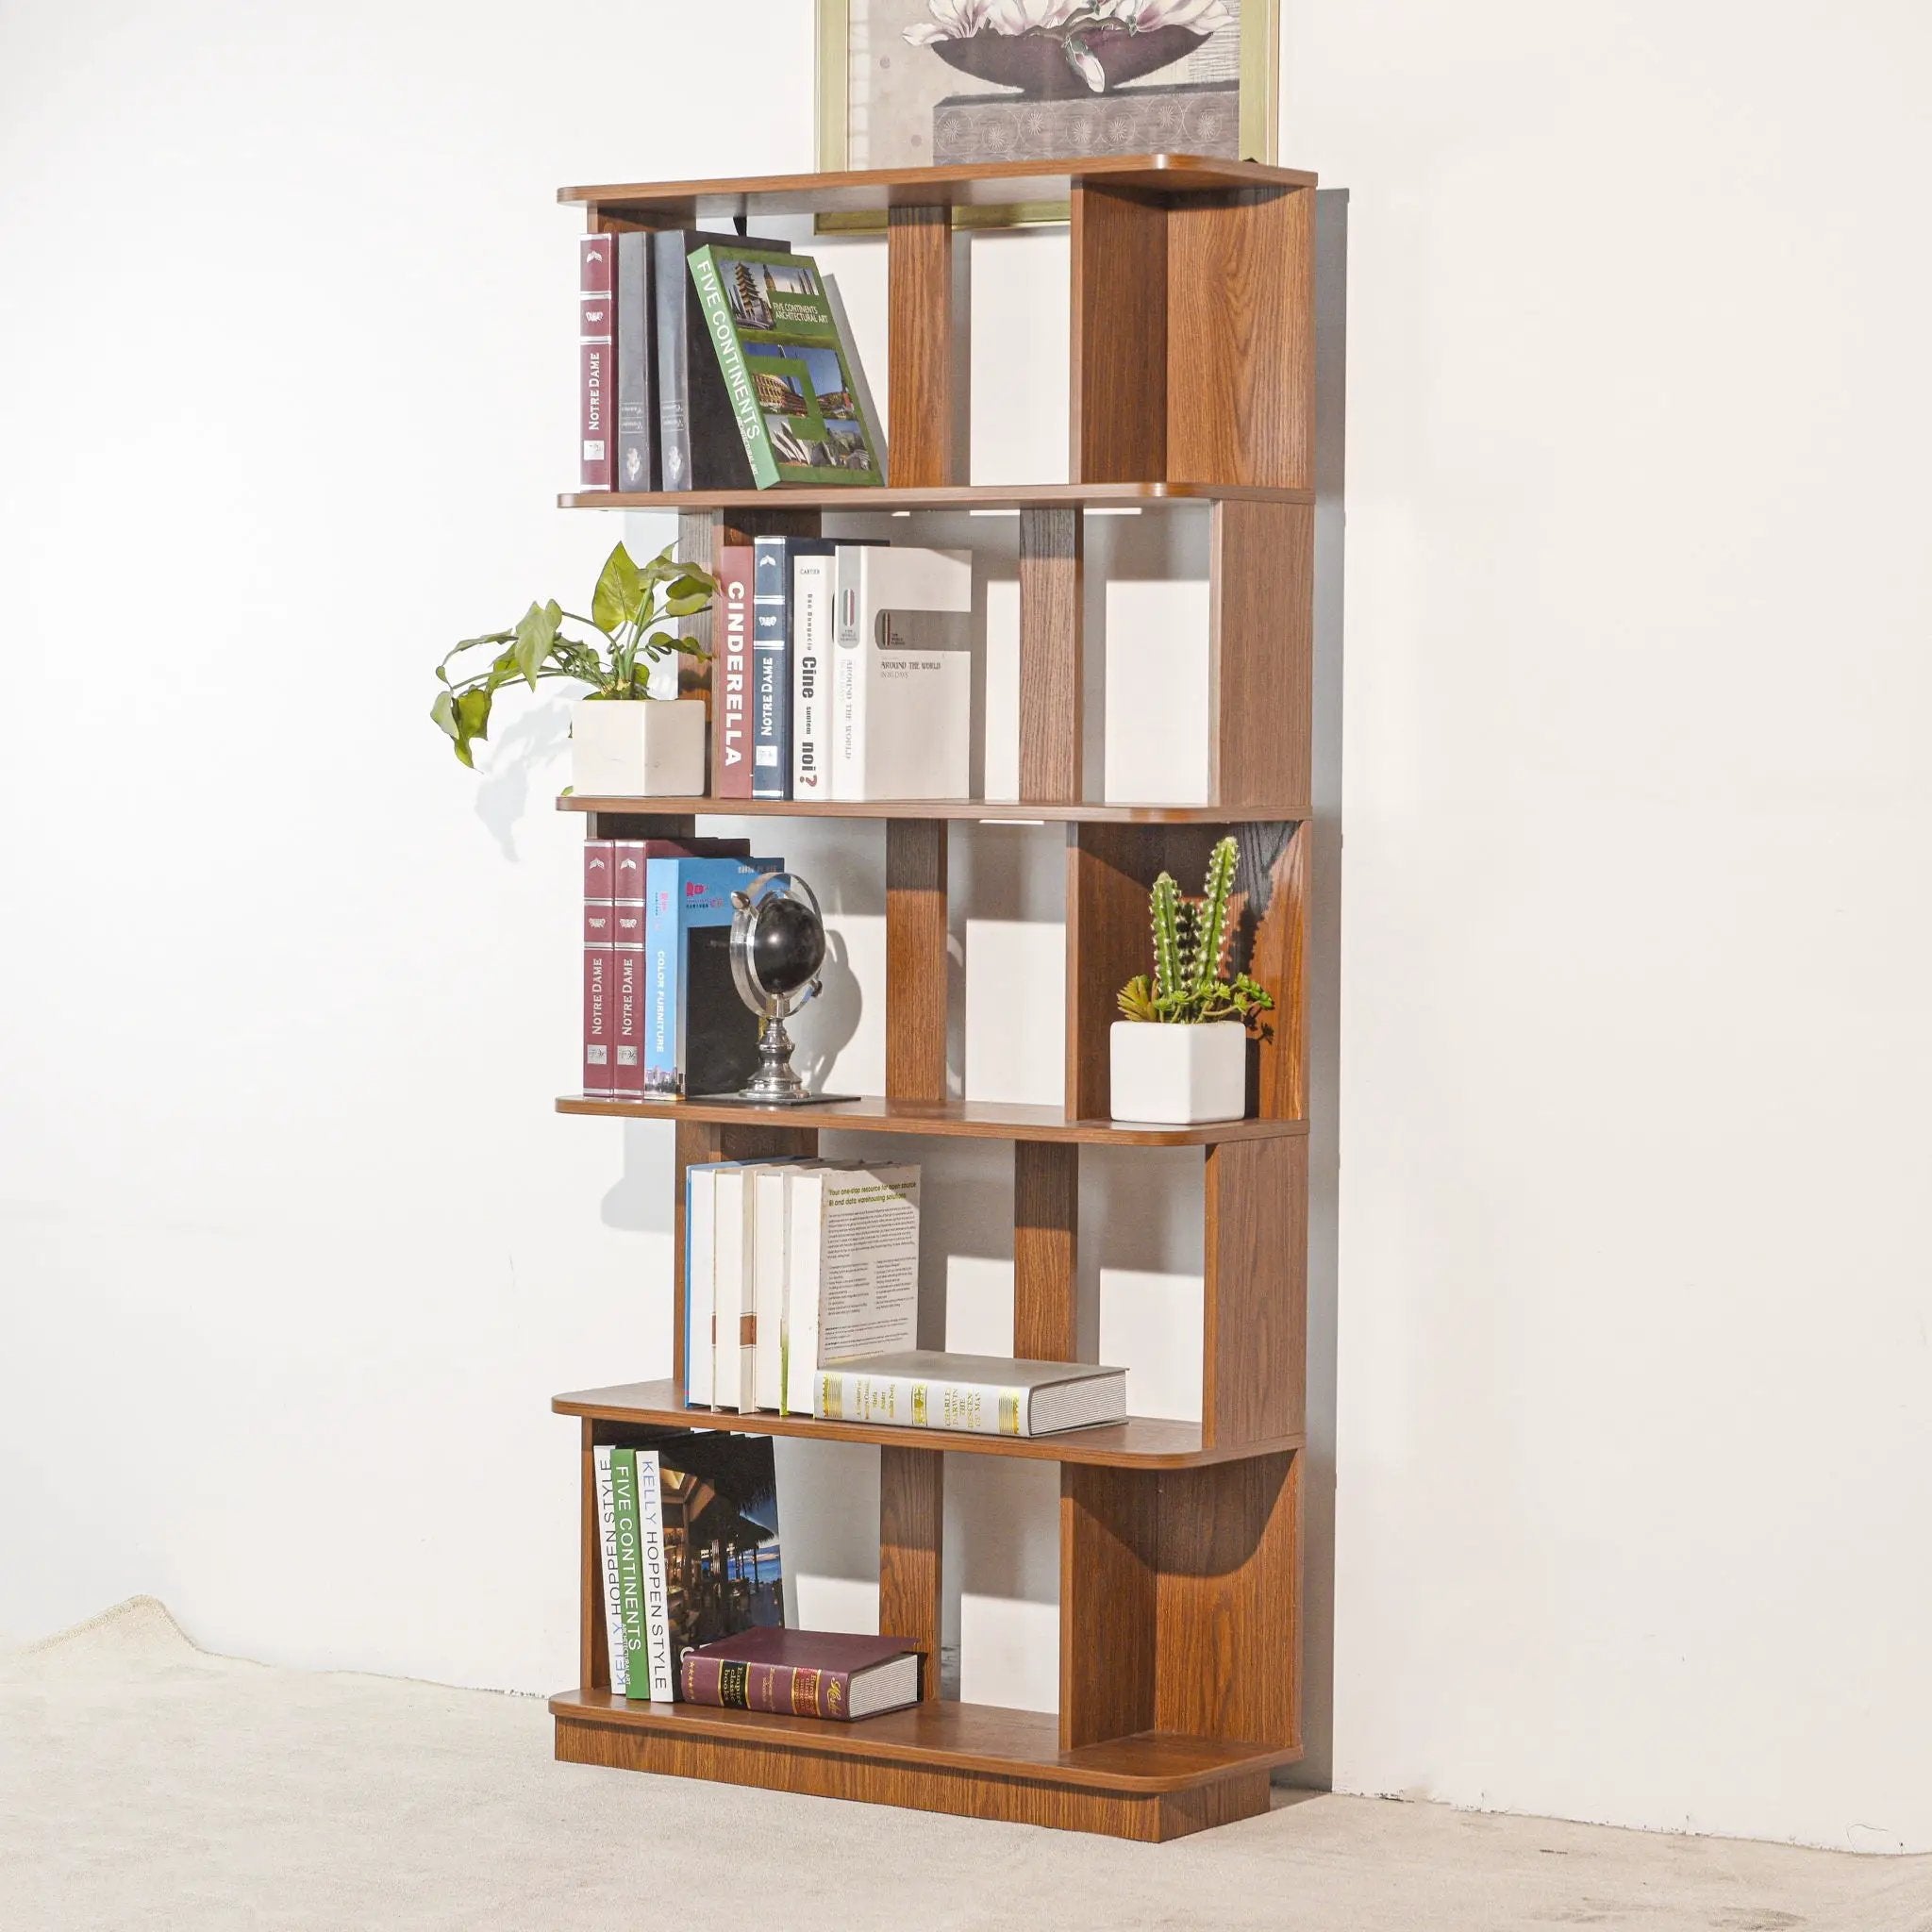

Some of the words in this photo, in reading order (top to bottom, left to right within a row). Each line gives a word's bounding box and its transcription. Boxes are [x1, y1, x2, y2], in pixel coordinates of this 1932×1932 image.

[773, 302, 786, 310] FIVE
[786, 303, 818, 314] CONTINENTS
[775, 311, 816, 323] ARCHITECTURAL
[816, 314, 828, 323] ART
[697, 258, 721, 308] FIVE
[712, 311, 760, 440] CONTINENTS
[588, 352, 600, 389] DAME
[588, 391, 600, 430] NOTRE
[724, 581, 744, 766] CINDERELLA
[760, 657, 774, 694] DAME
[802, 657, 817, 698] Cine
[881, 661, 907, 670] AROUND
[760, 696, 774, 736] NOTRE
[592, 958, 602, 993] DAME
[622, 958, 633, 994] DAME
[592, 995, 602, 1035] NOTRE
[622, 996, 632, 1036] NOTRE
[599, 1459, 614, 1524] STYLE
[615, 1465, 631, 1513] FIVE
[641, 1460, 657, 1524] KELLY
[606, 1528, 620, 1616] HOPPEN
[619, 1518, 641, 1651] CONTINENTS
[646, 1530, 662, 1617] HOPPEN
[652, 1626, 668, 1690] STYLE
